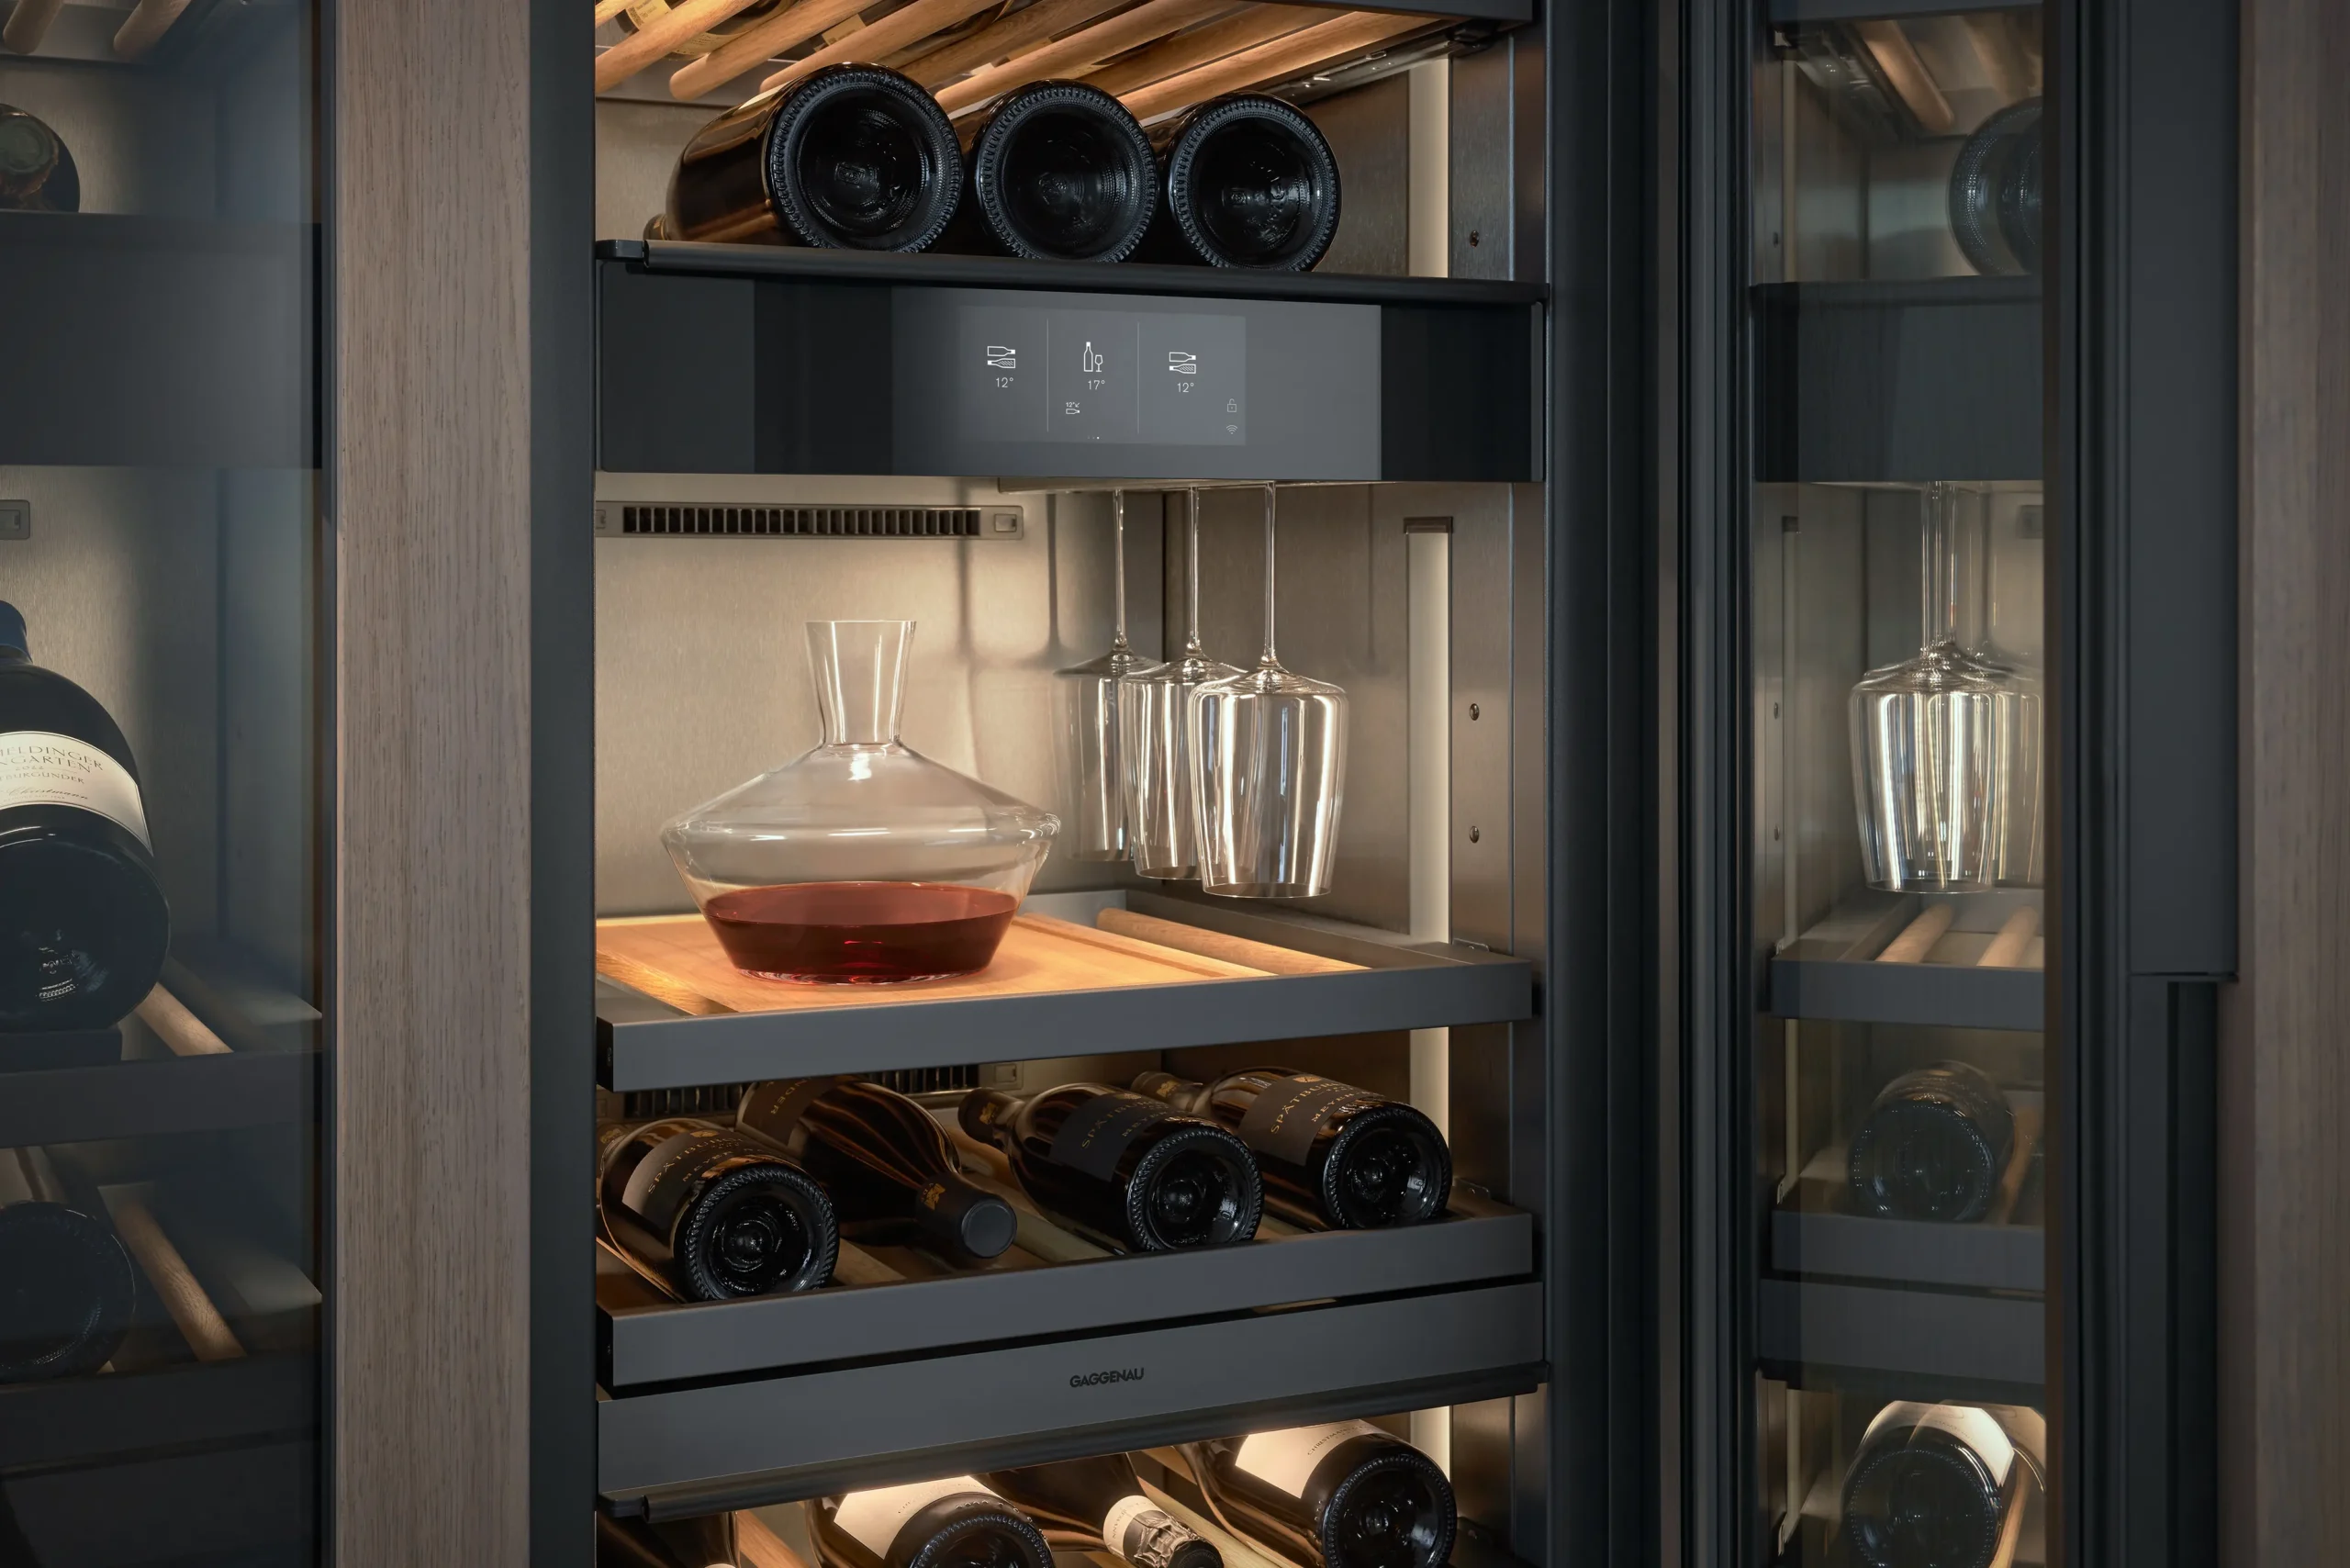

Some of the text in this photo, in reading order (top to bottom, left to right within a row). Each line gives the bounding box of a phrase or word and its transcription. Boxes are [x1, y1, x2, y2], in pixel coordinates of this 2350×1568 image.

[996, 377, 1014, 388] 12°
[1088, 379, 1105, 390] 17°
[1177, 382, 1194, 393] 12°
[0, 745, 104, 771] ELDINGER
[1069, 1367, 1145, 1388] GAGGENAU
